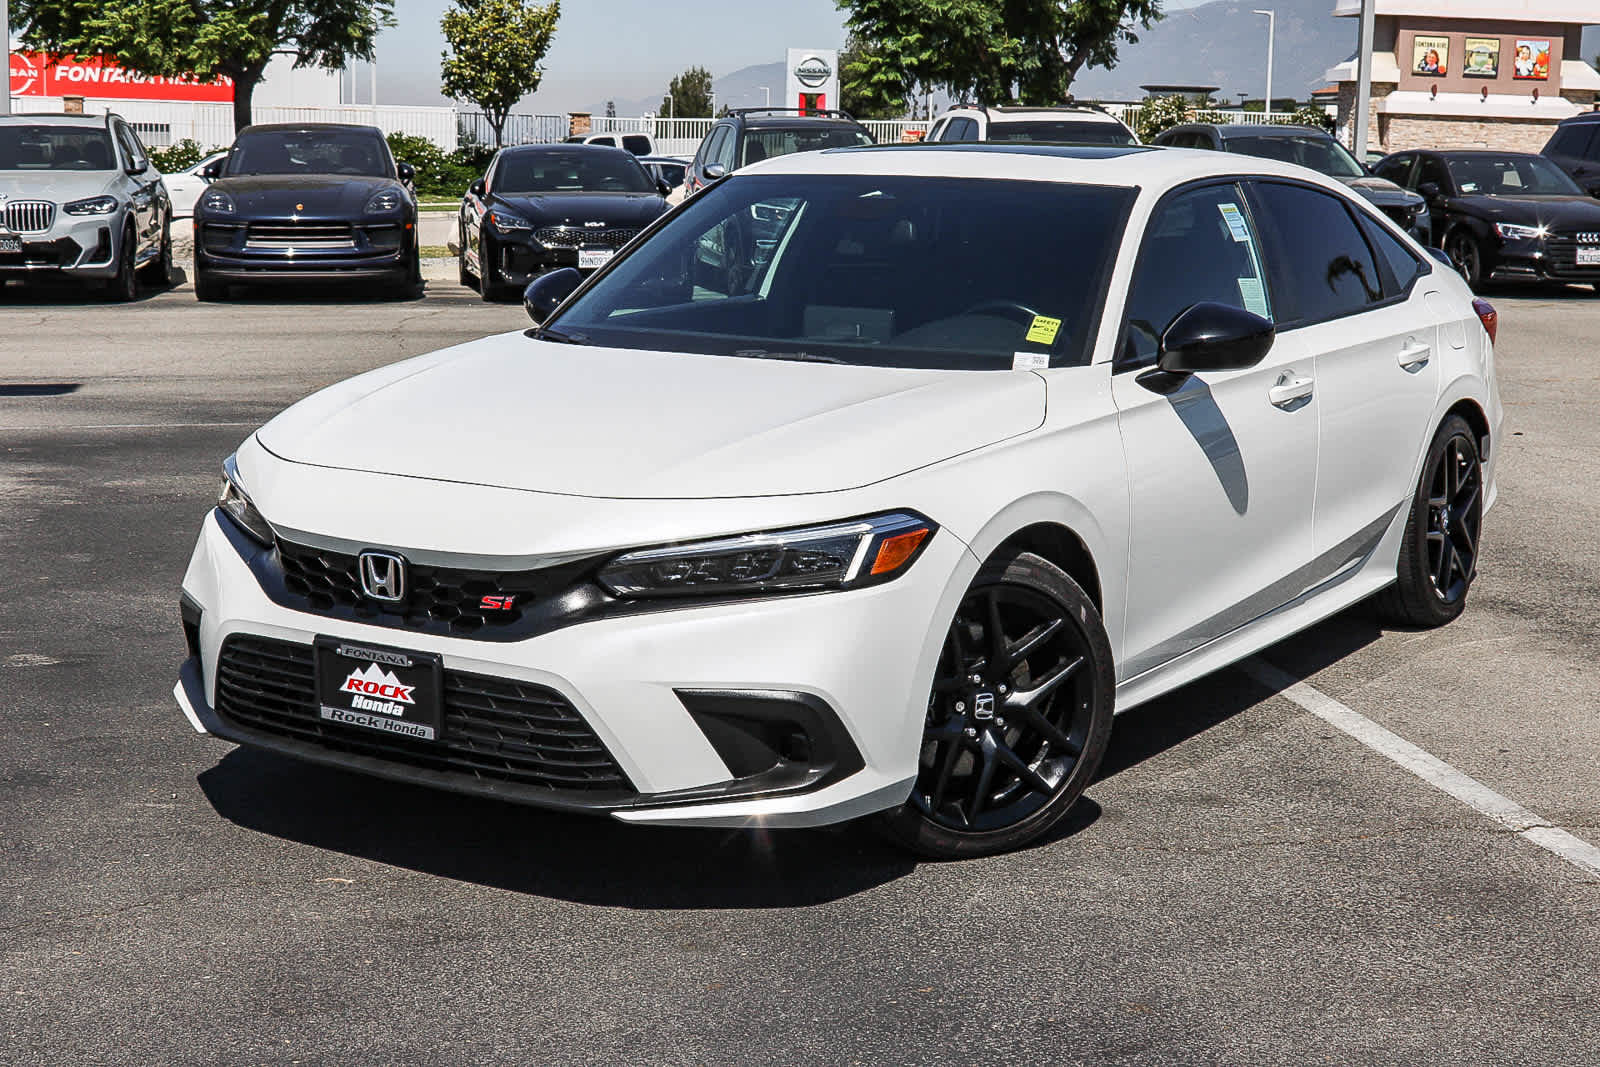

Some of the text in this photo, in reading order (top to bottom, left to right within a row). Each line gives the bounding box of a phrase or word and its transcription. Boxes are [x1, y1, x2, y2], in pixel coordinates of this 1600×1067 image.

[9, 68, 38, 77] SAN
[480, 595, 512, 610] Si
[344, 647, 406, 665] FONTANA
[347, 678, 410, 700] ROCK
[351, 694, 405, 717] Honda
[331, 709, 427, 738] Rock Honda
